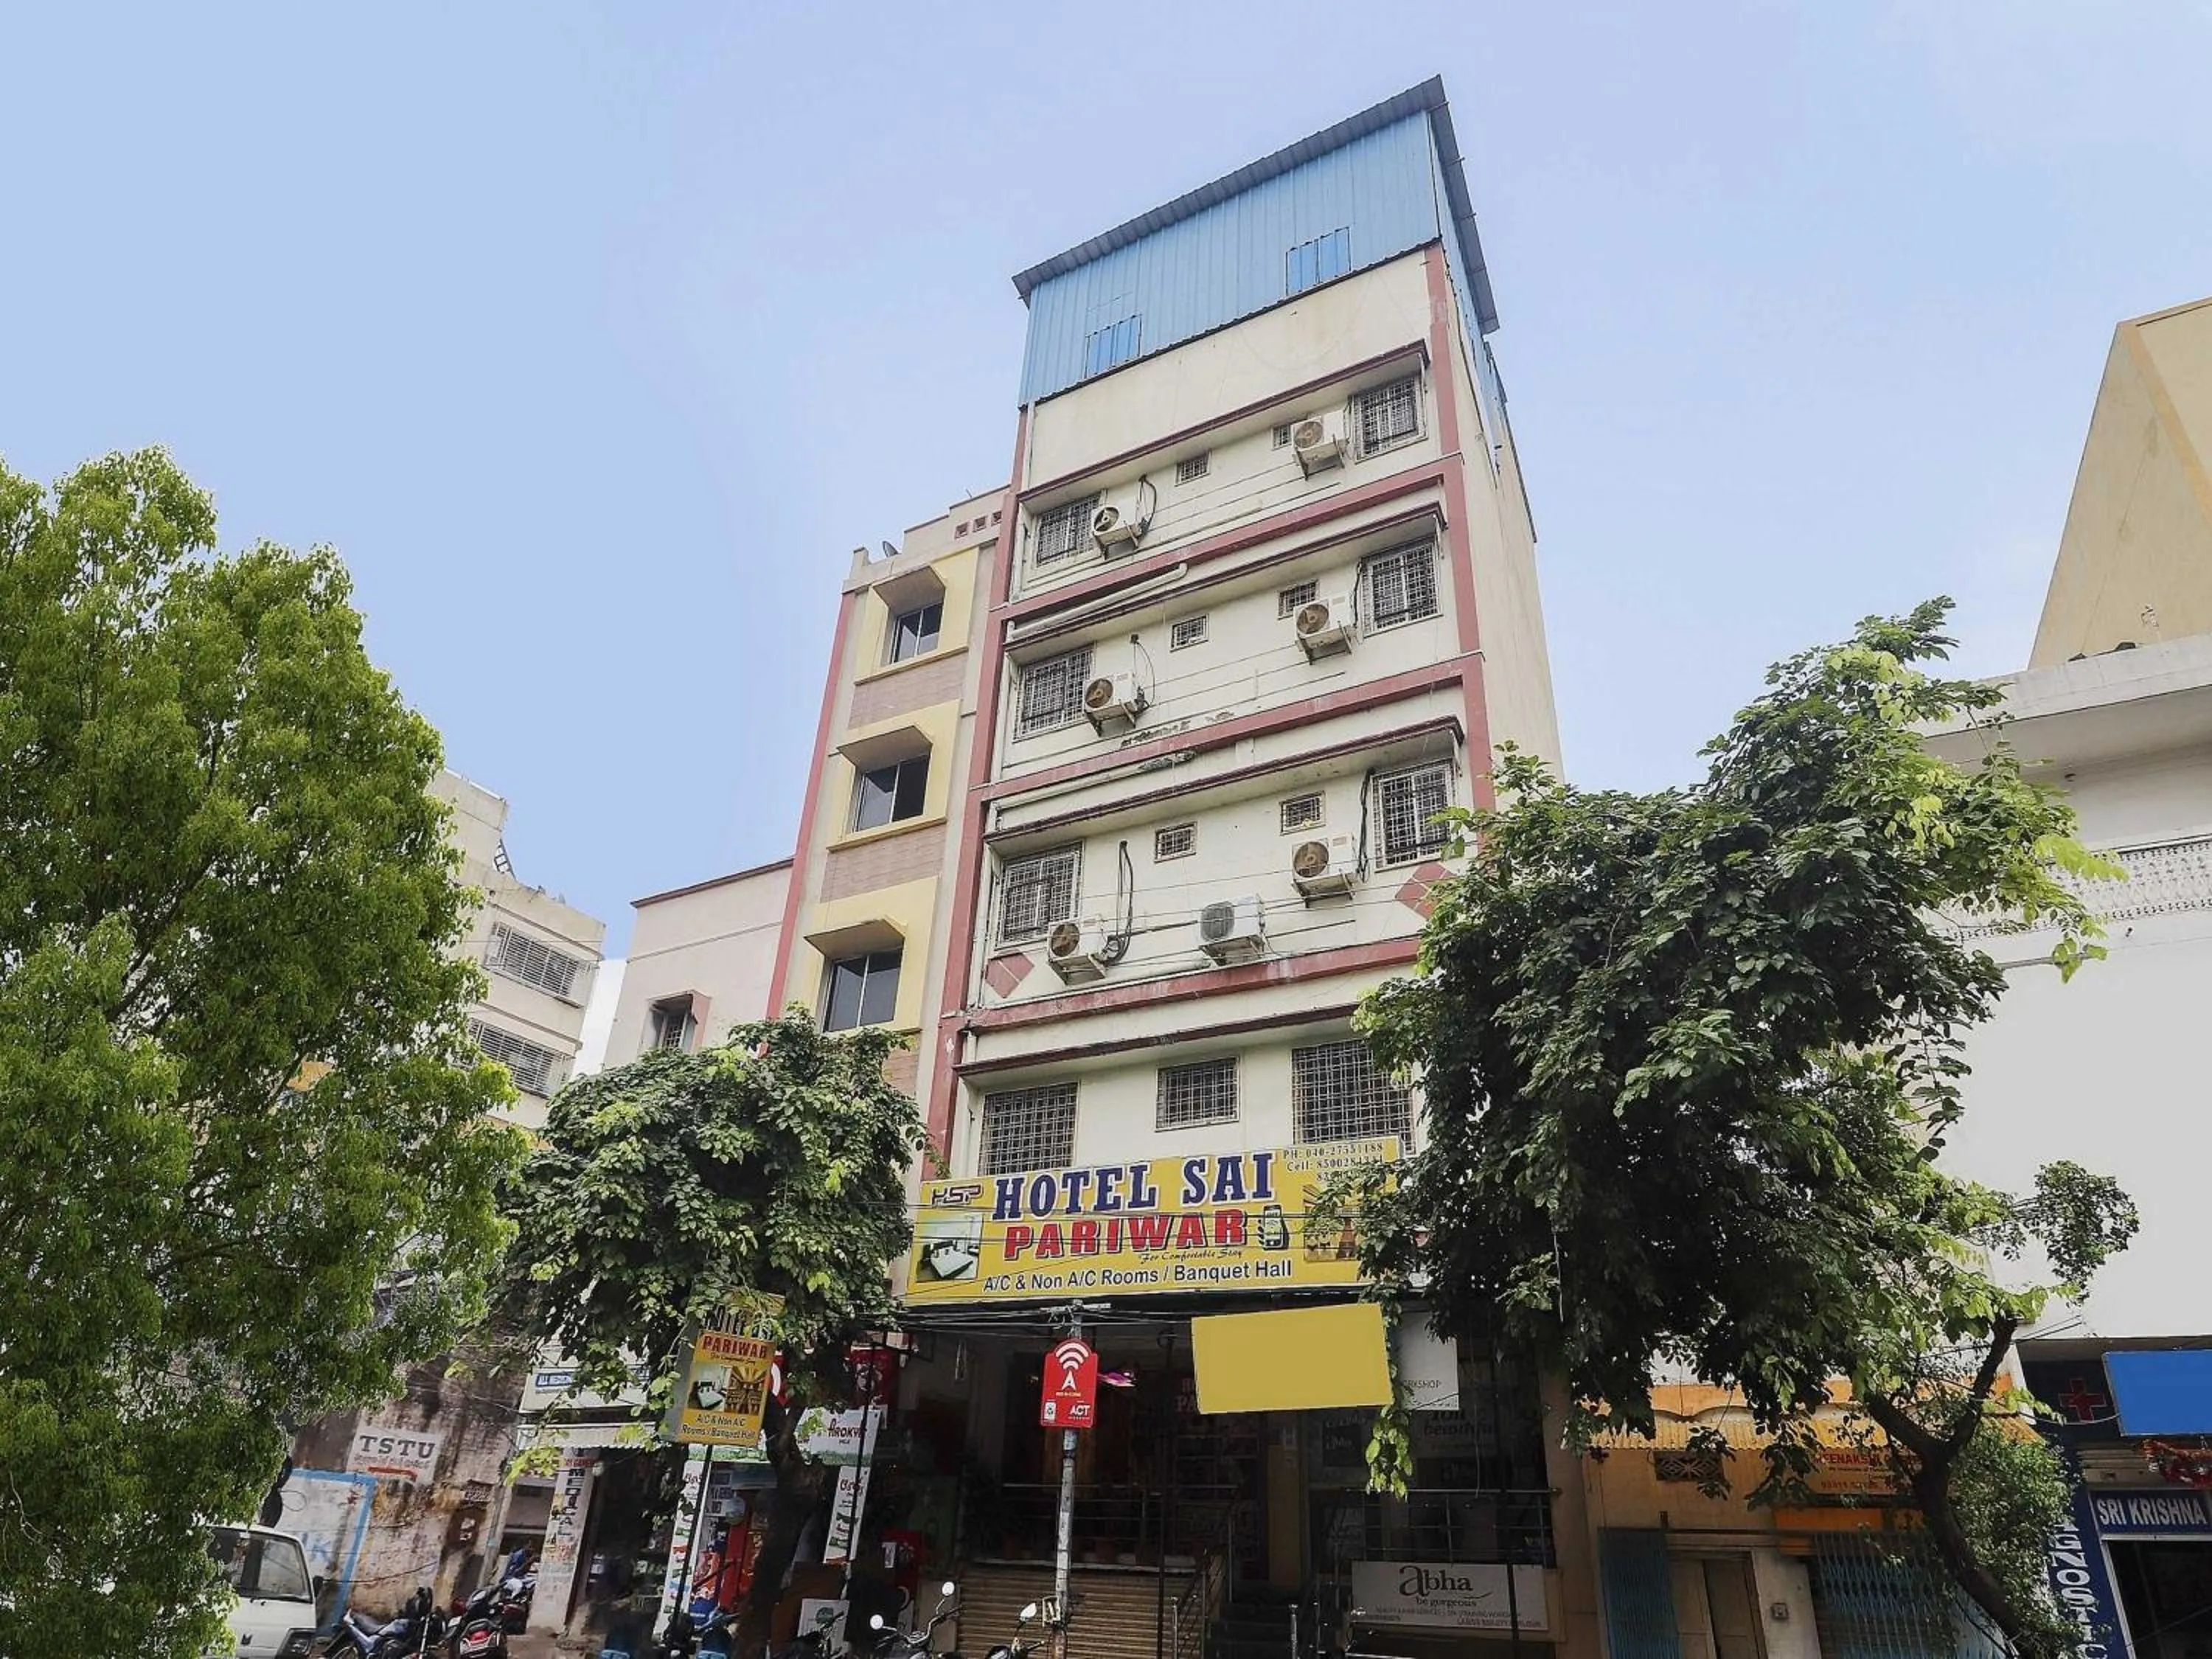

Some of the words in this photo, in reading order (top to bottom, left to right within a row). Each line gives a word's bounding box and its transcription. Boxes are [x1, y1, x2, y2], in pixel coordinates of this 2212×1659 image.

[992, 1164, 1157, 1220] HOTEL
[1182, 1152, 1273, 1205] SAI
[1004, 1208, 1248, 1261] PARIWAR
[983, 1276, 1011, 1292] A/C
[1015, 1275, 1026, 1289] &
[1032, 1273, 1062, 1289] Non
[1067, 1270, 1096, 1287] A/C
[1102, 1268, 1158, 1285] Rooms
[1175, 1262, 1250, 1282] Banquet
[1256, 1260, 1292, 1277] Hall
[1070, 1405, 1091, 1416] ACT
[359, 1435, 436, 1458] TSTU
[2097, 1498, 2127, 1525] SRI
[2128, 1498, 2208, 1526] KRISHNA
